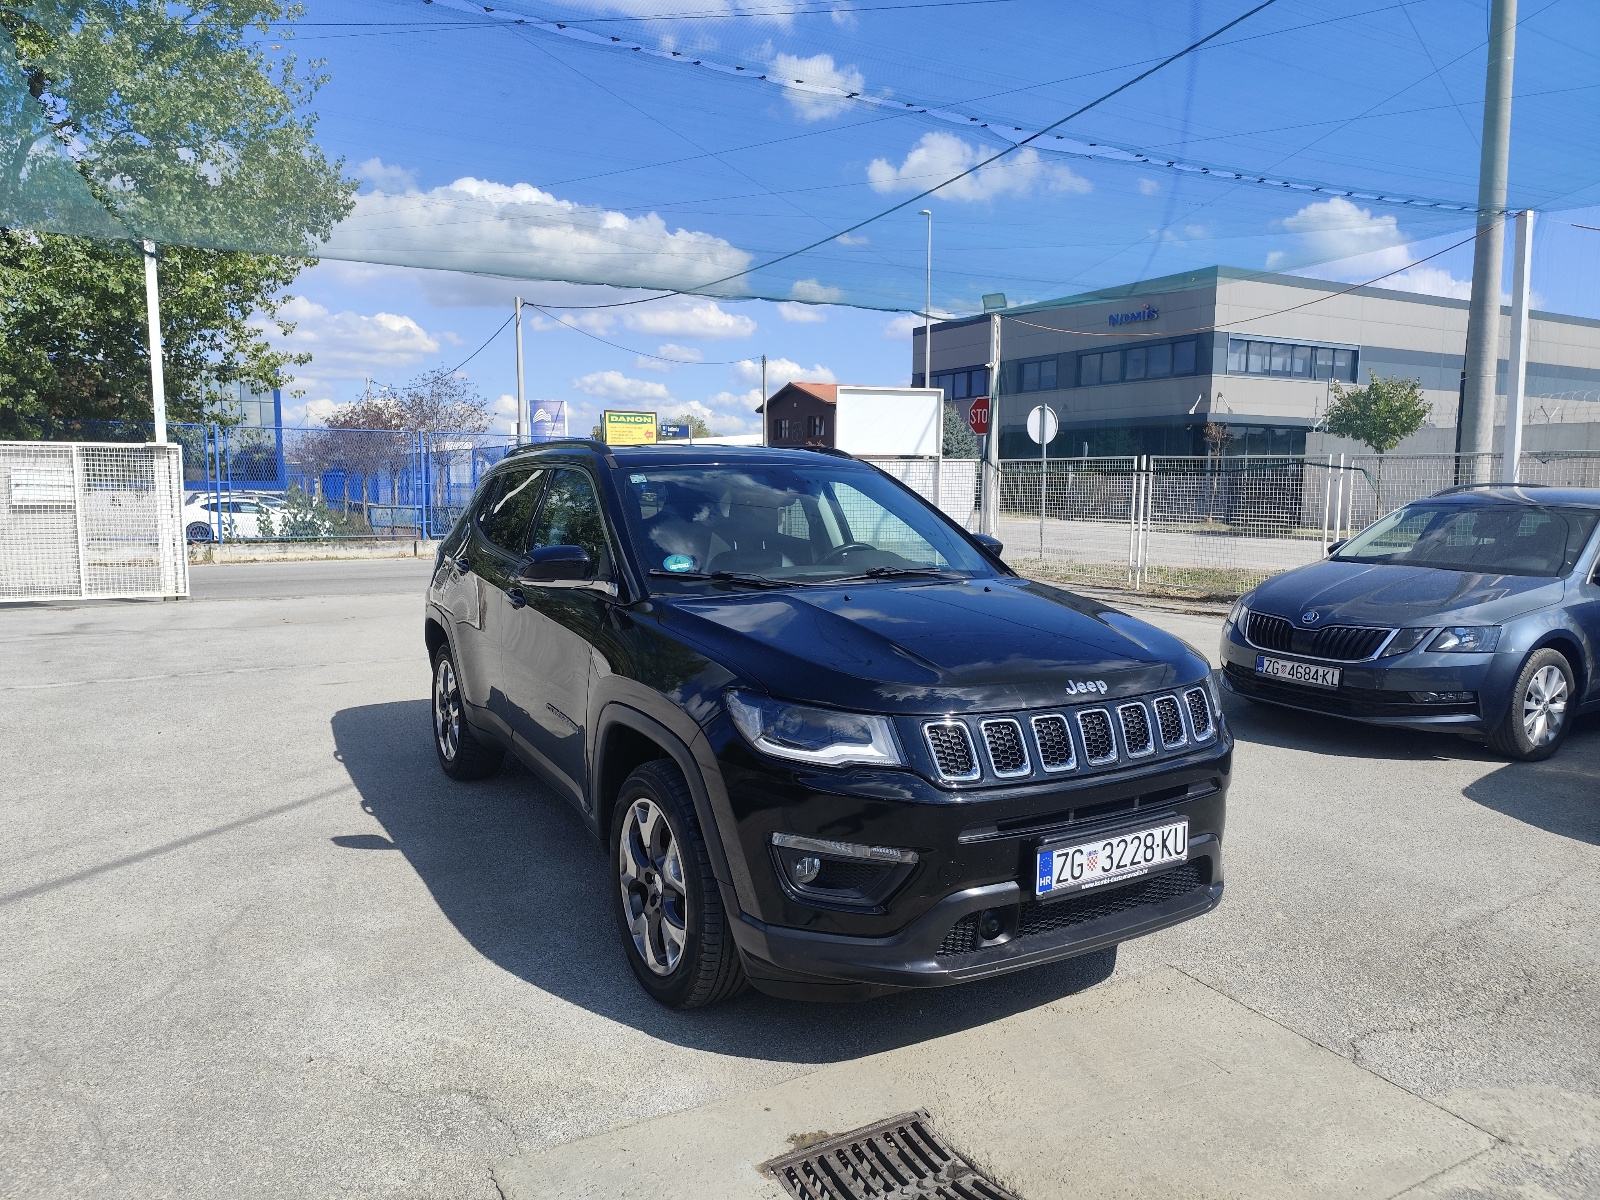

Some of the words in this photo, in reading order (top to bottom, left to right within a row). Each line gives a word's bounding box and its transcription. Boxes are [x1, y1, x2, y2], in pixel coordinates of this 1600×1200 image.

[610, 415, 652, 424] DANON
[970, 408, 988, 425] STO
[1264, 659, 1280, 675] ZG
[1288, 664, 1338, 687] 4684-KL
[1065, 679, 1108, 695] Jeep
[1055, 849, 1084, 884] ZG
[1101, 825, 1187, 873] 3228-KU
[1039, 876, 1052, 887] HR
